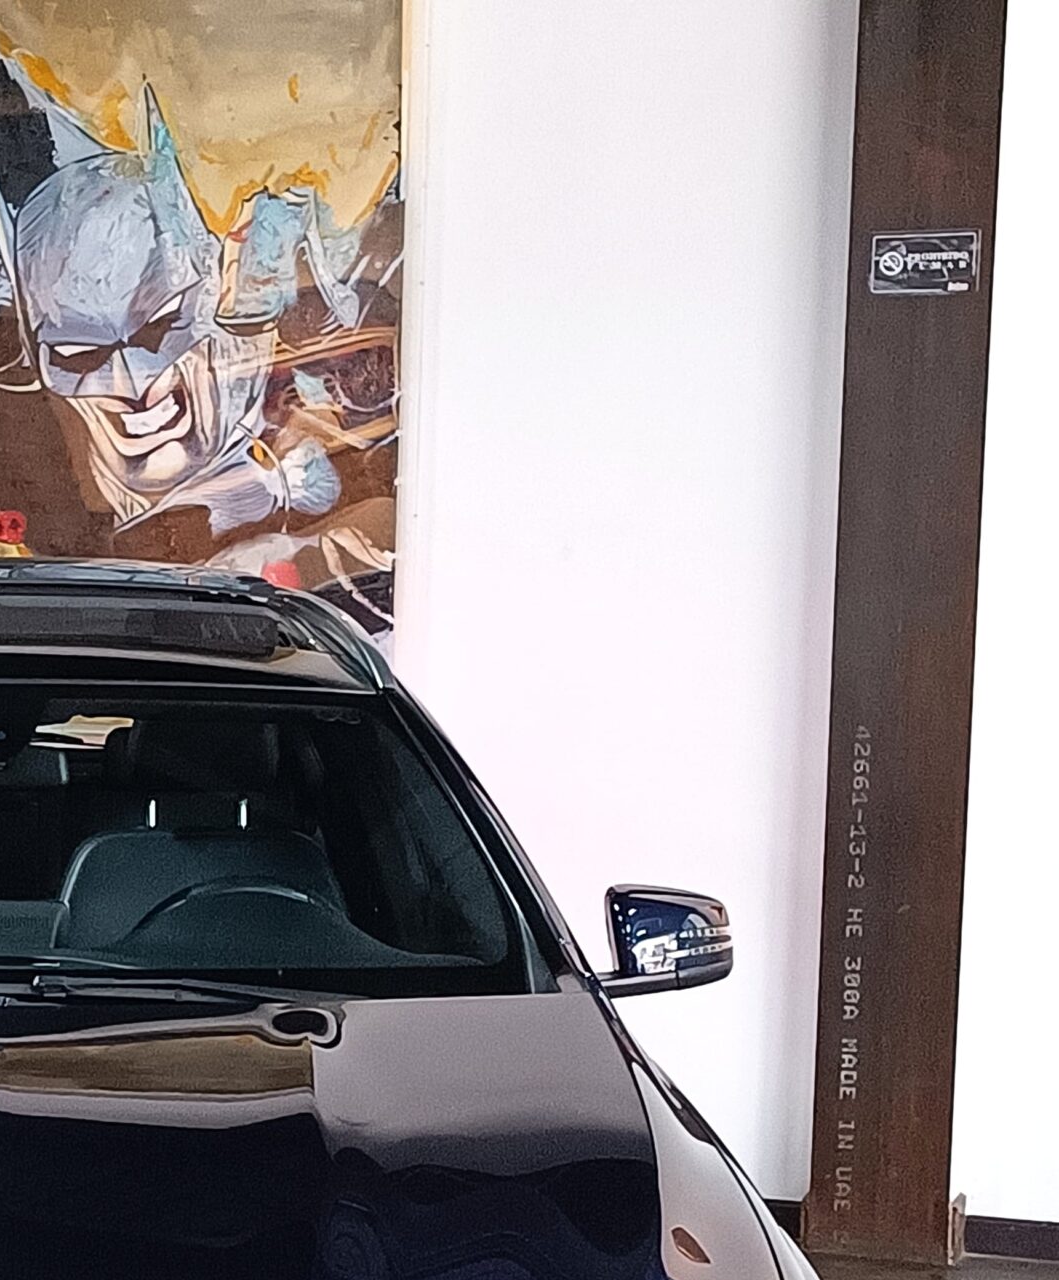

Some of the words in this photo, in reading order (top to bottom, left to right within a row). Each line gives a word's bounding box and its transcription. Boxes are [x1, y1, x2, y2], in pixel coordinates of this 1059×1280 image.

[845, 908, 863, 938] HE
[839, 1038, 858, 1100] MADE
[837, 1120, 855, 1149] IN
[833, 1166, 853, 1212] UAE
